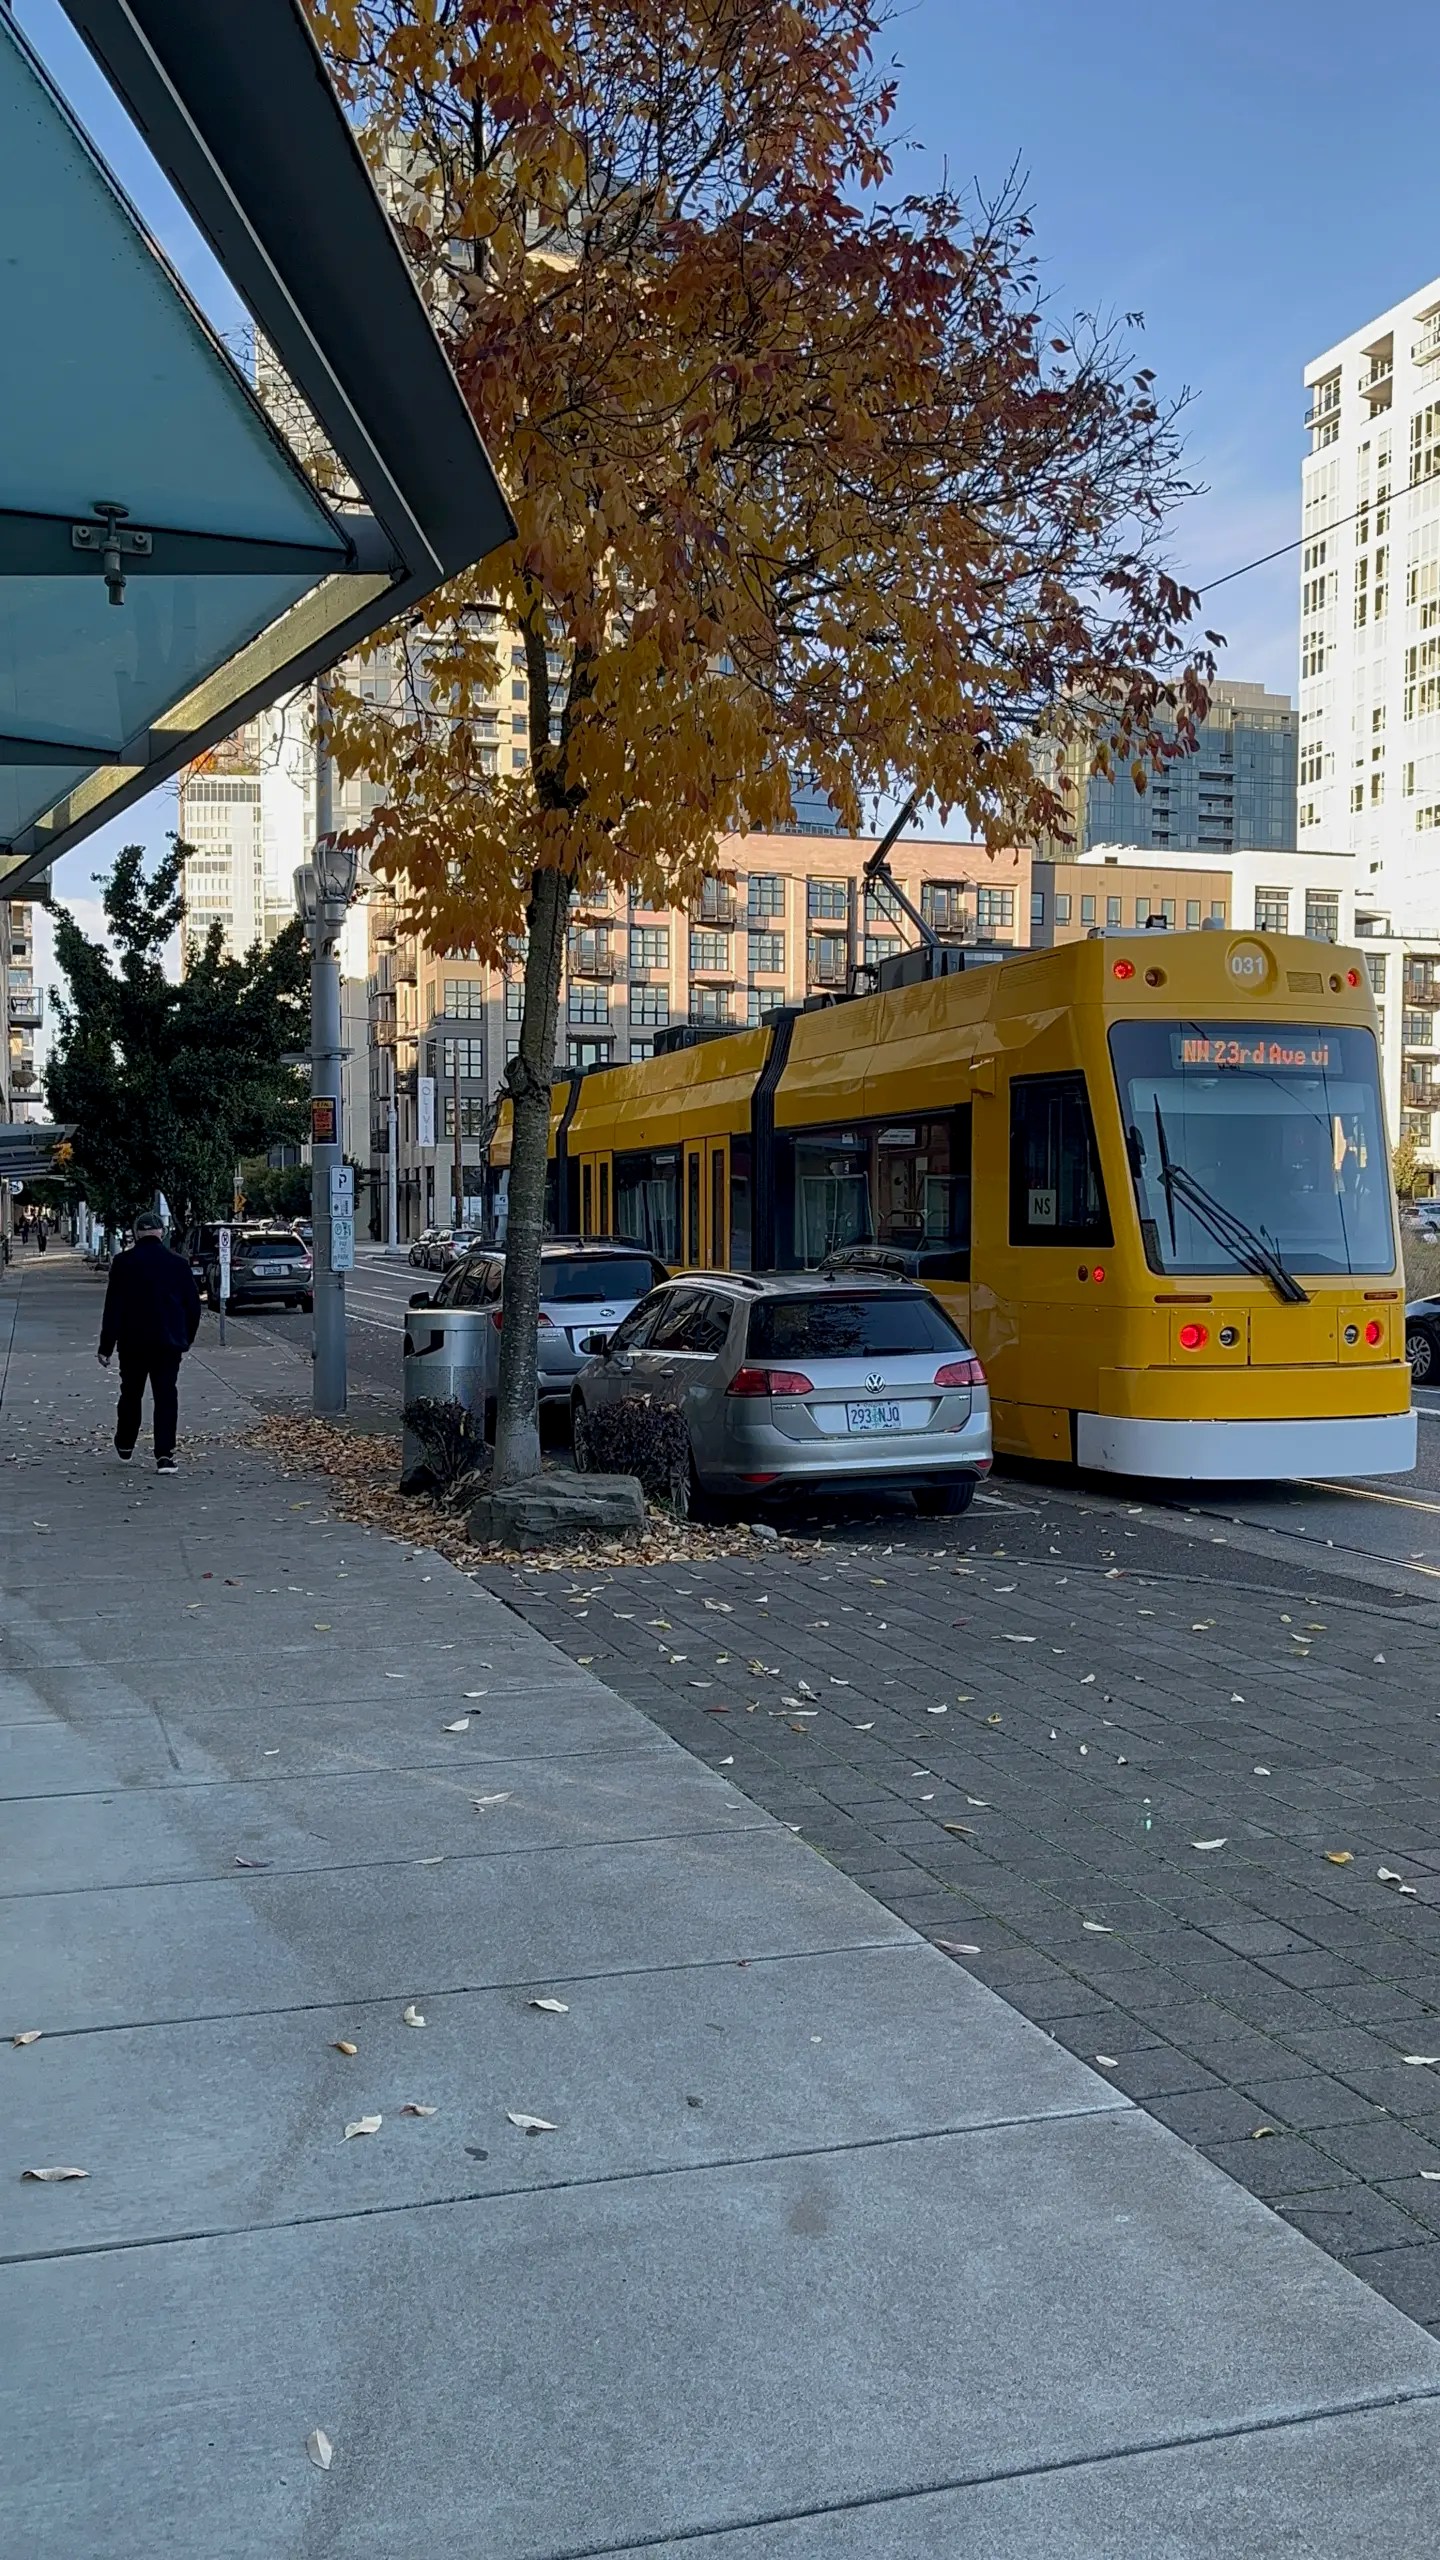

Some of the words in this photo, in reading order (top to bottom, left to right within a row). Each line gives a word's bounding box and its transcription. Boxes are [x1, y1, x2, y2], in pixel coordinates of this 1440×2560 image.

[1231, 956, 1263, 975] 031
[1182, 1040, 1209, 1063] NW
[1214, 1041, 1264, 1064] 23rd
[1269, 1043, 1306, 1065] Ave
[1311, 1045, 1329, 1065] vi
[421, 1086, 431, 1144] OLIVIA
[1034, 1197, 1051, 1215] NS
[850, 1408, 872, 1424] 293
[878, 1406, 900, 1422] NJQ
